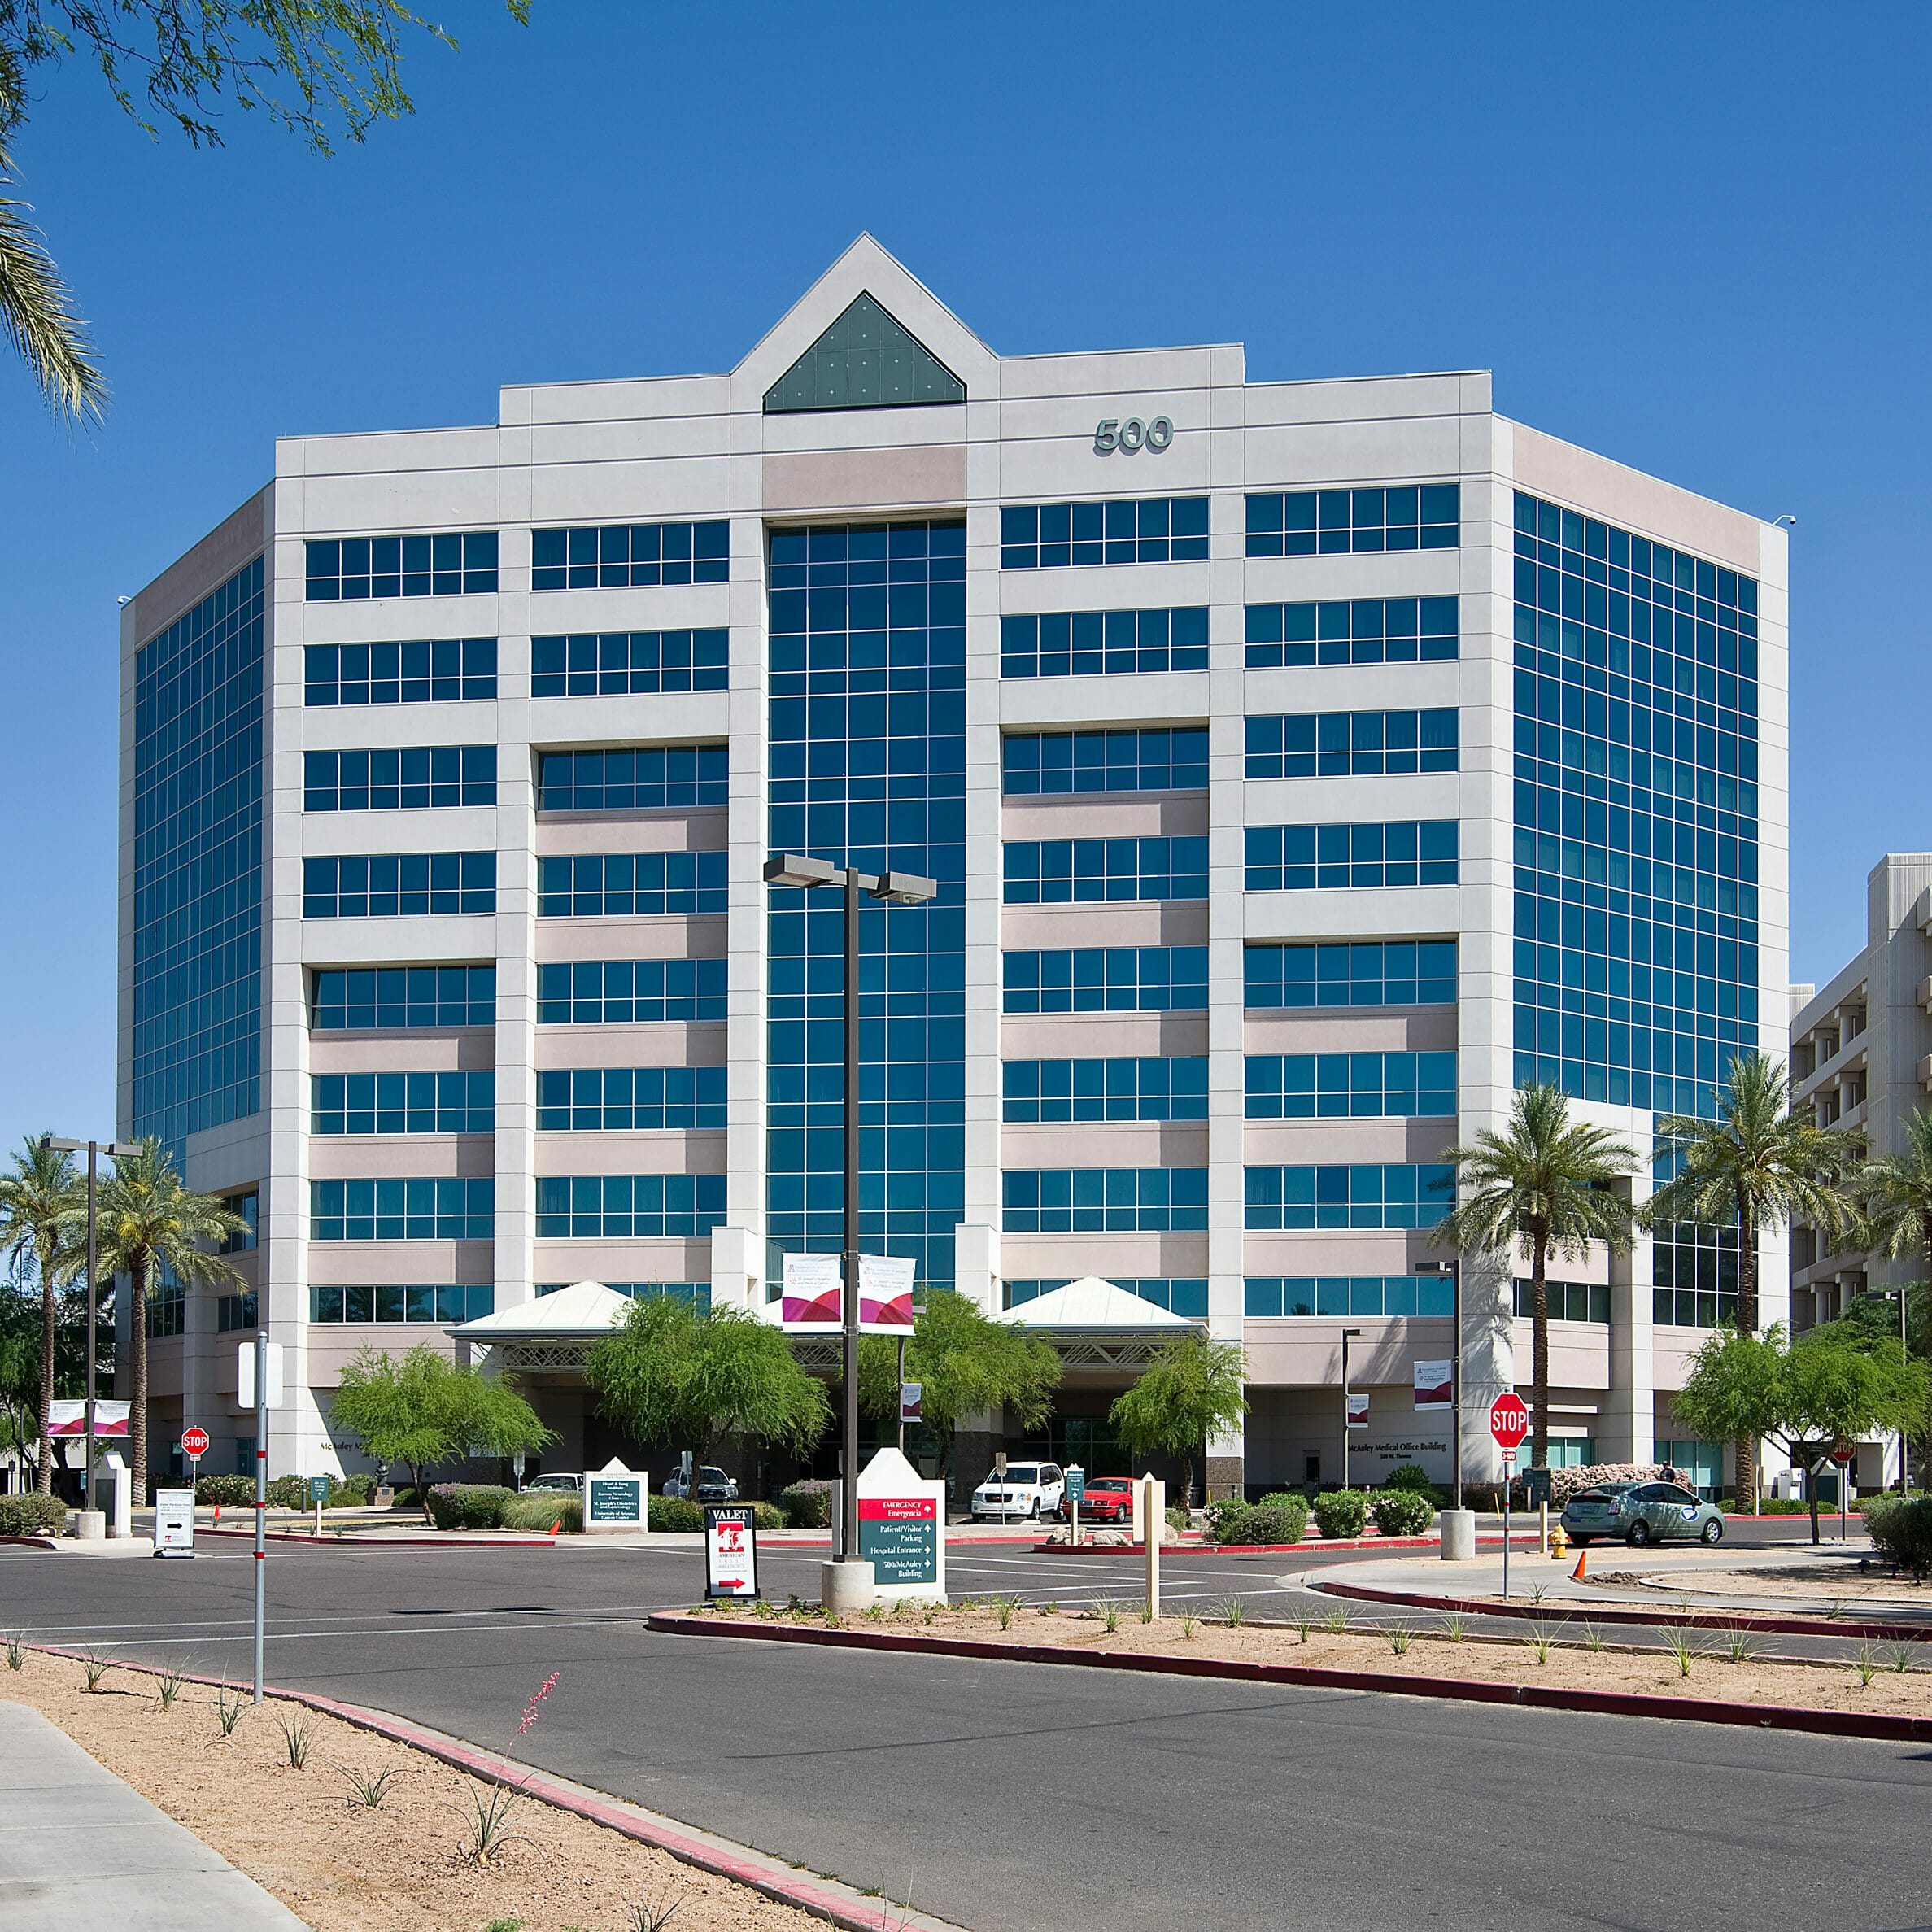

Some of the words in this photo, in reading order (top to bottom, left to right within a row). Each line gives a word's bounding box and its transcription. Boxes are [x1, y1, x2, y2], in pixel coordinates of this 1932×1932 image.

[1094, 416, 1174, 450] 500
[1492, 1411, 1526, 1432] STOP
[184, 1436, 207, 1447] STOP
[321, 1441, 353, 1452] McAuley
[1375, 1442, 1398, 1451] Medical
[1400, 1442, 1420, 1451] Office
[1420, 1441, 1446, 1452] Building
[712, 1509, 748, 1520] VALET
[888, 1510, 922, 1519] Emergencia
[901, 1534, 922, 1543] Parking
[870, 1546, 896, 1555] Hospital
[883, 1560, 922, 1568] 500/McAuley
[898, 1570, 922, 1578] Building
